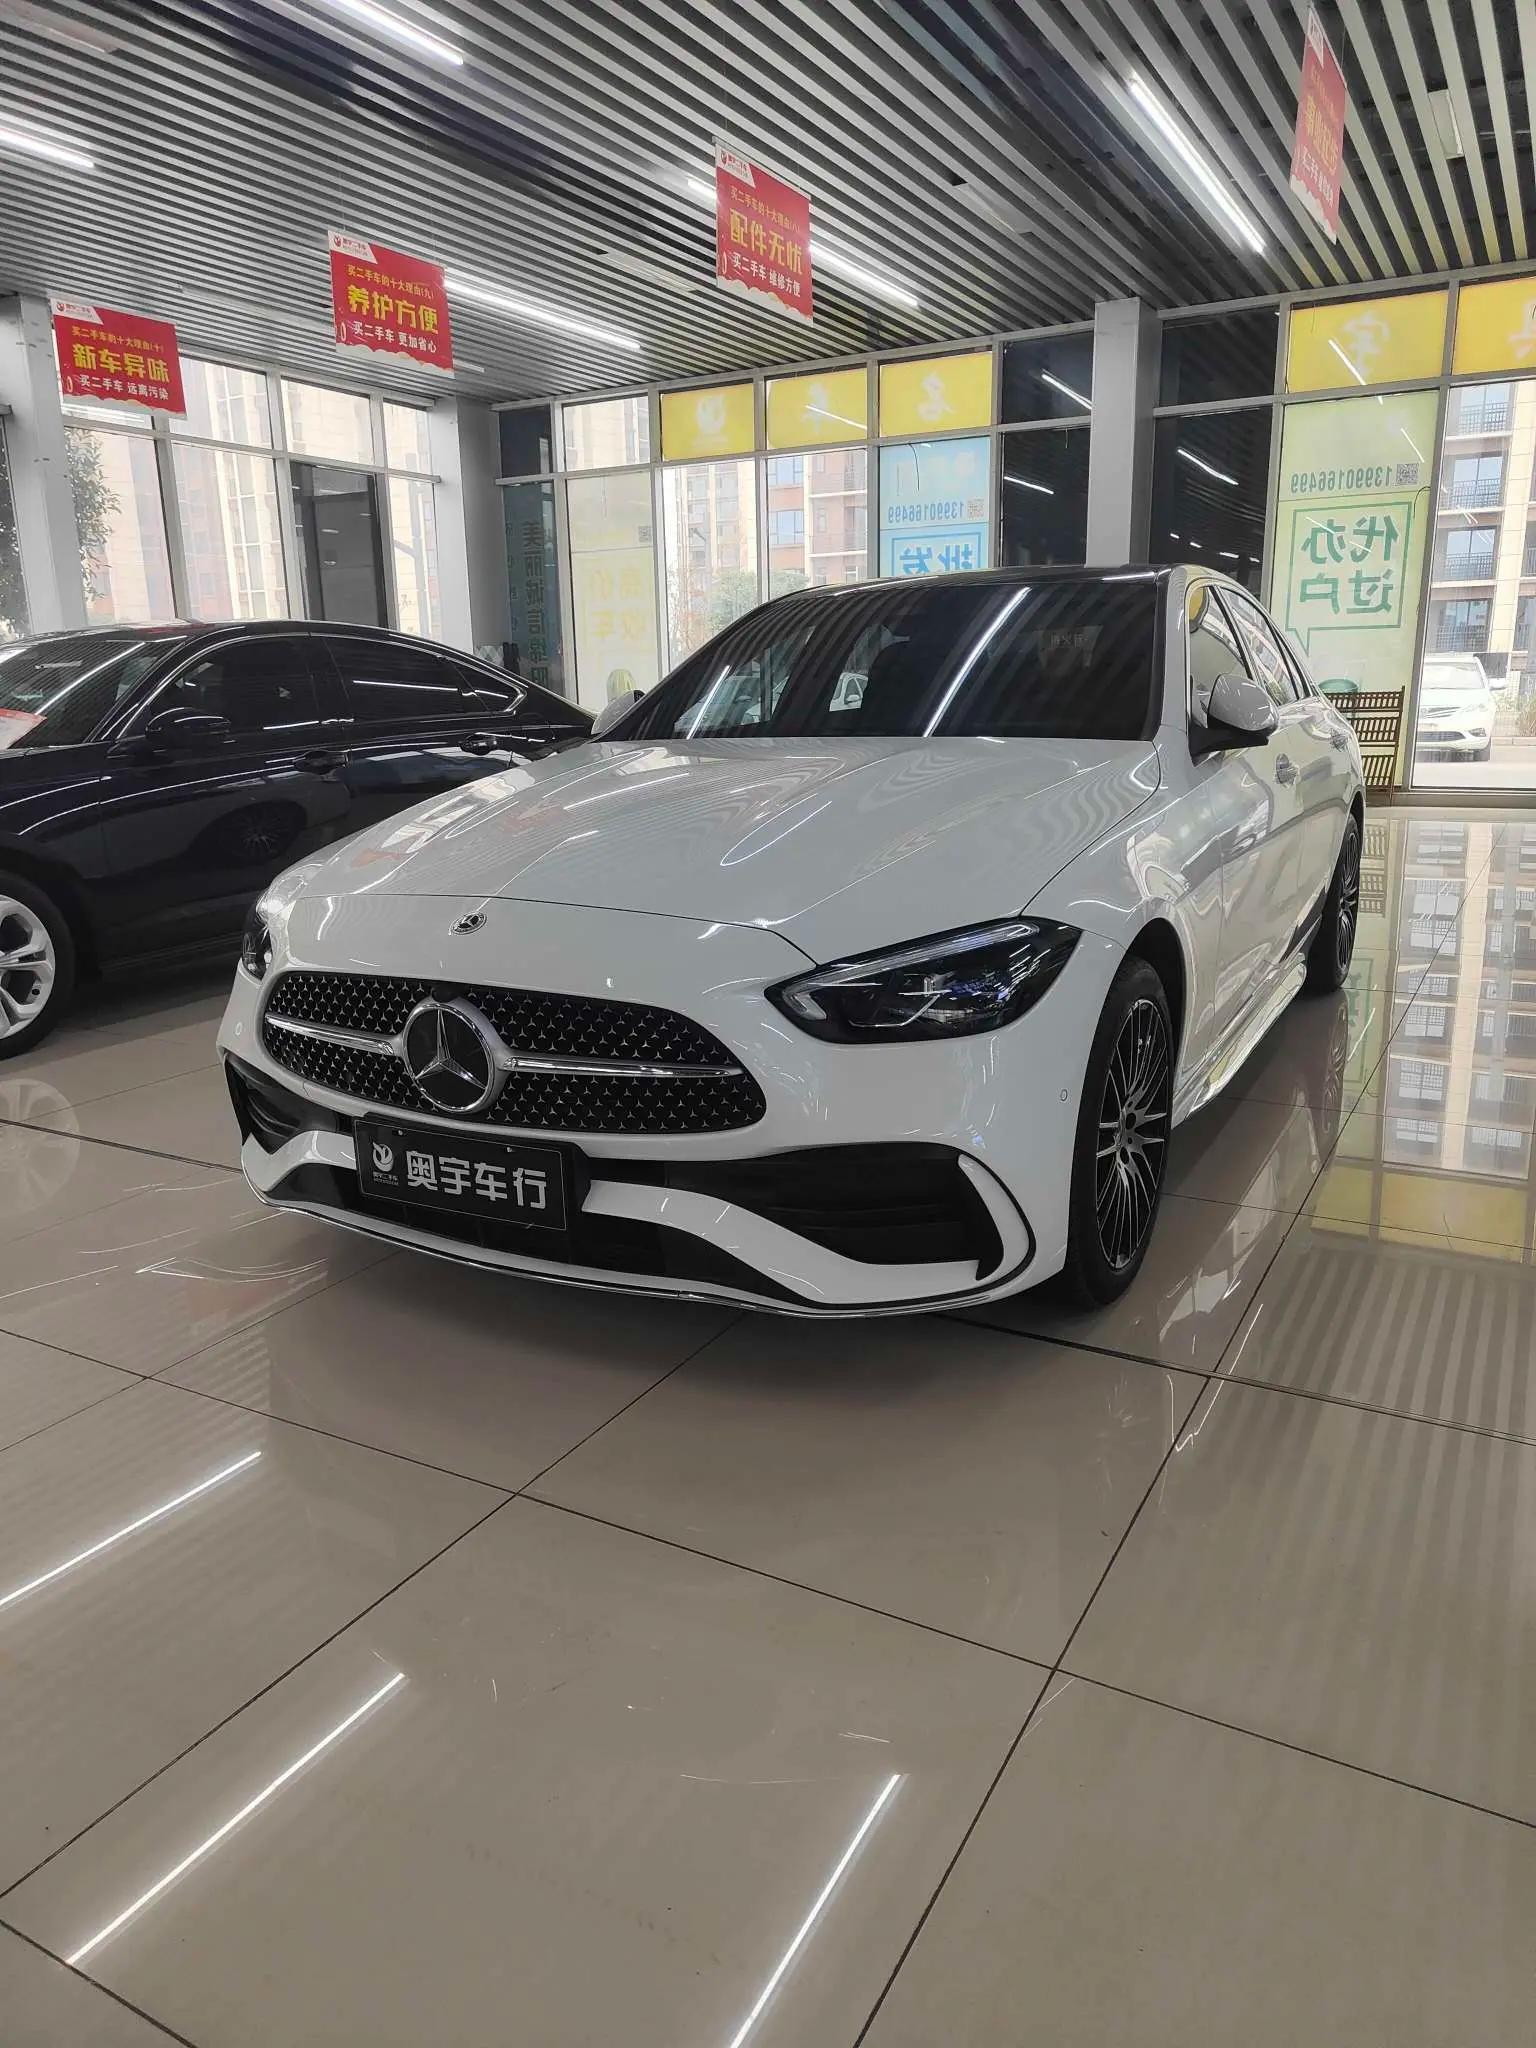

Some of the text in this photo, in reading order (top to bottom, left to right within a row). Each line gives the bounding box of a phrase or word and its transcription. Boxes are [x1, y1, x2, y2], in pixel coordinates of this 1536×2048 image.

[729, 209, 803, 274] 配件无忧
[732, 252, 801, 297] 买二手车 维修方便
[347, 284, 439, 335] 养护方便
[353, 320, 437, 353] 买二手车 更加省心
[72, 343, 170, 384] 新车异味
[79, 374, 169, 400] 买二手车 远离污染
[406, 1151, 546, 1208] 奥宇车行
